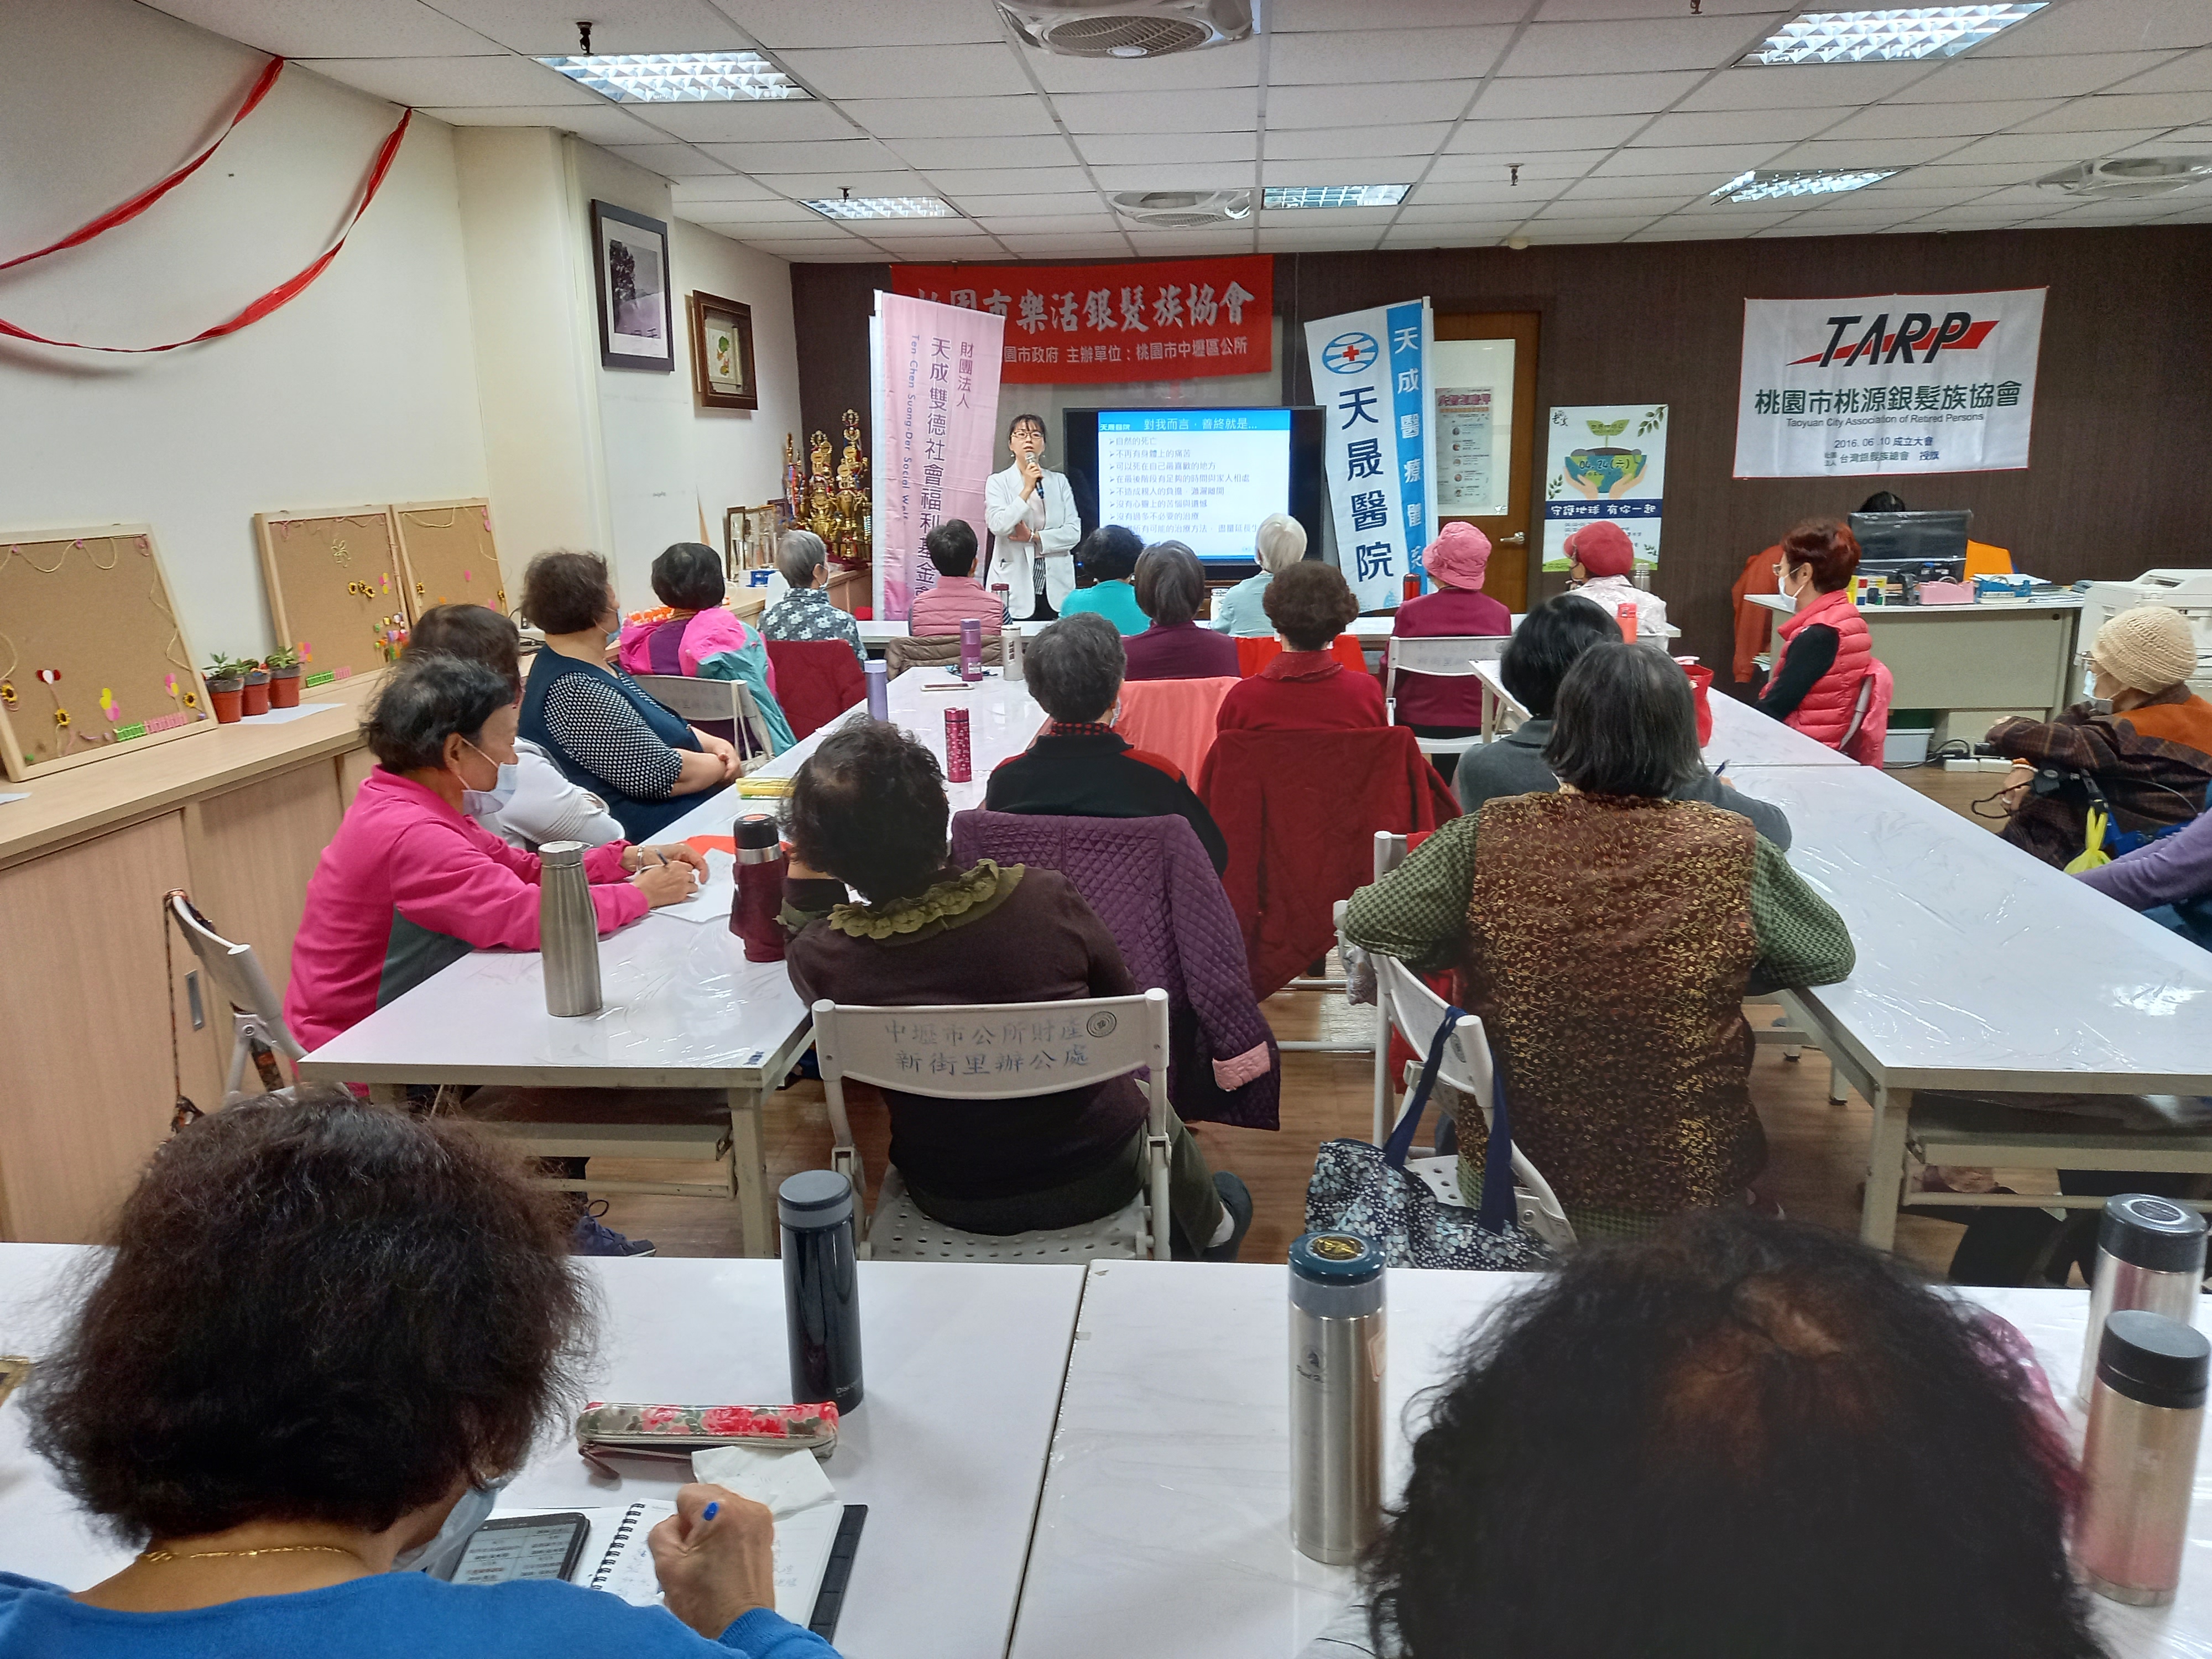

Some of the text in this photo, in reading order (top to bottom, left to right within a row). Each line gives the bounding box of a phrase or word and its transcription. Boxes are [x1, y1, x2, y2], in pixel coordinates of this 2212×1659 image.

[918, 281, 1254, 334] 市樂活銀髮族協會
[911, 334, 920, 354] Ten
[1004, 346, 1058, 363] 園市政府
[1819, 311, 1972, 367] TARP
[908, 360, 918, 388] Chen
[956, 341, 974, 409] 財團法人
[1754, 380, 2022, 415] 桃園市桃源銀髮族協會
[1786, 413, 1984, 428] Taoyuan City Association of Retired Persons
[1893, 436, 1934, 446] 成立大會
[902, 457, 912, 488] Social
[1338, 385, 1394, 583] 天晟醫院
[1551, 504, 1657, 516] 守護地球 有你一起
[895, 1044, 1089, 1076] 新街里辦公處
